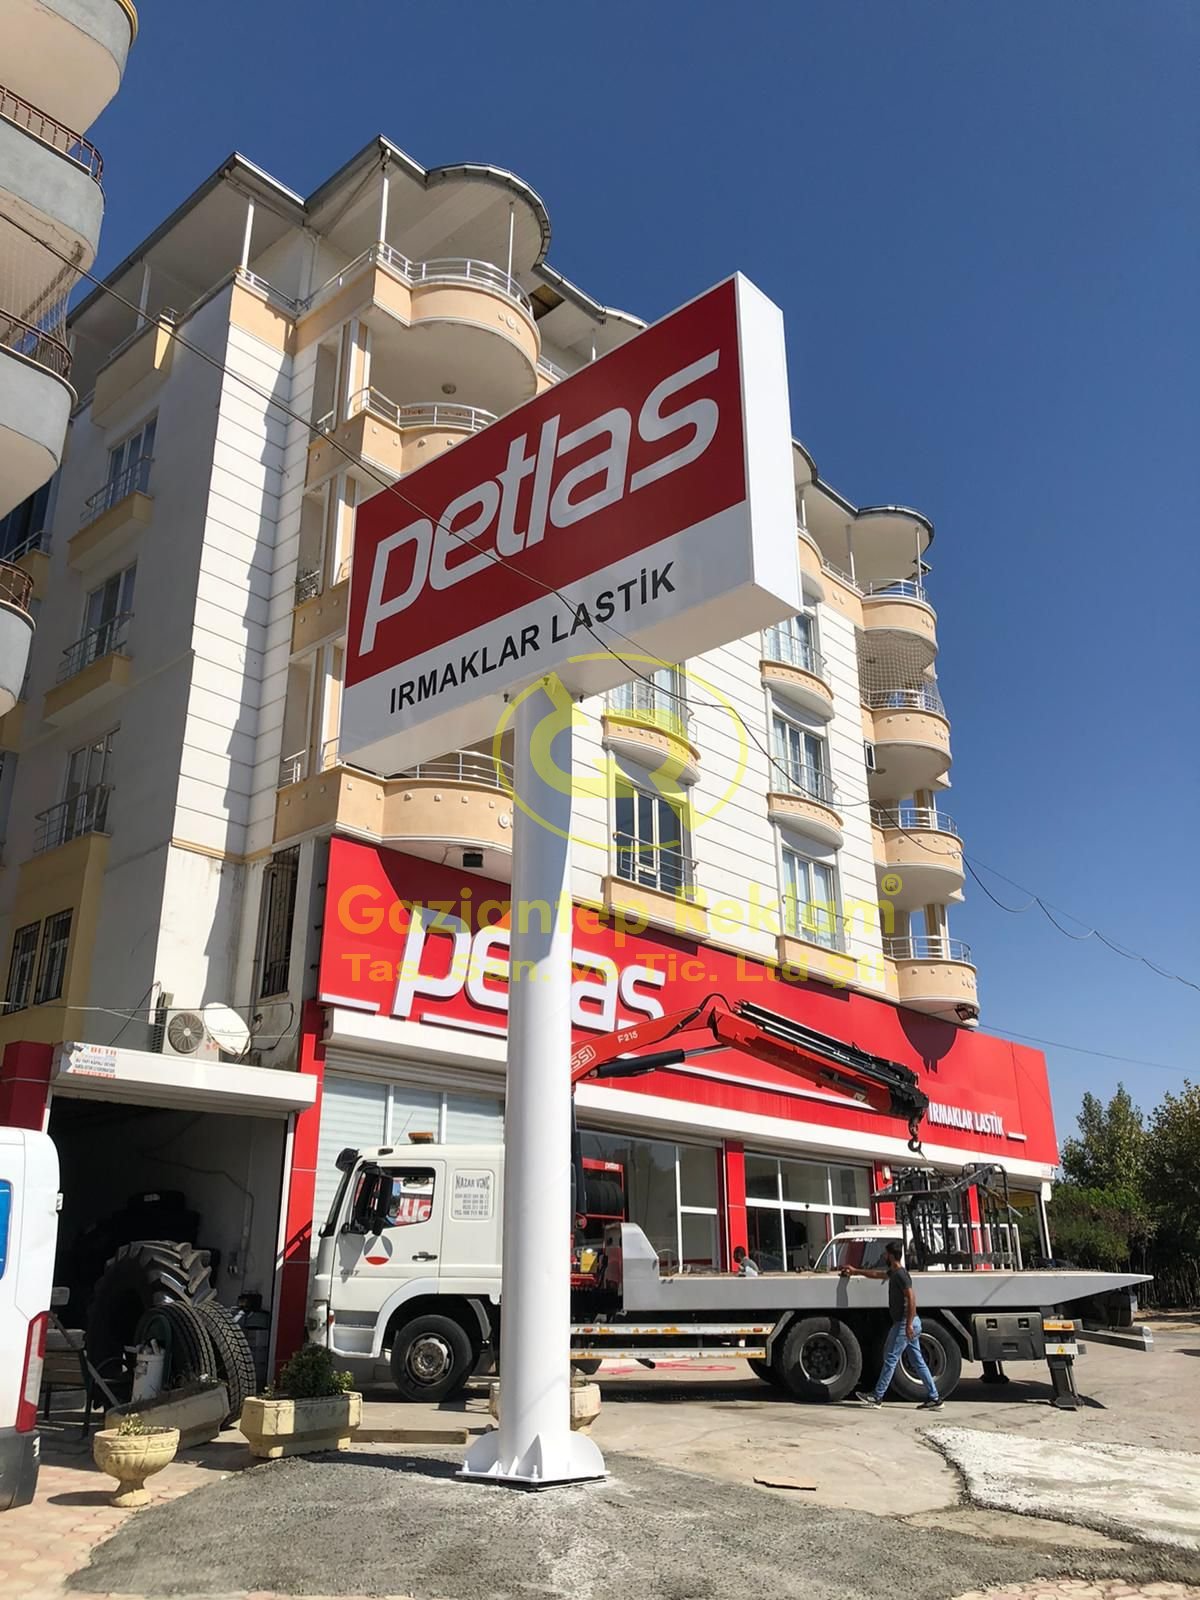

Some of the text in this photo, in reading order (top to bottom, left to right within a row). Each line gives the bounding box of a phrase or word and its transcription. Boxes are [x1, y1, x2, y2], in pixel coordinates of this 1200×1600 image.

[358, 349, 721, 657] petlas
[390, 562, 676, 714] IRMAKLAR LASTİK
[392, 904, 666, 1032] peas
[617, 1031, 639, 1044] F215
[928, 1101, 974, 1130] IRMAKLAR
